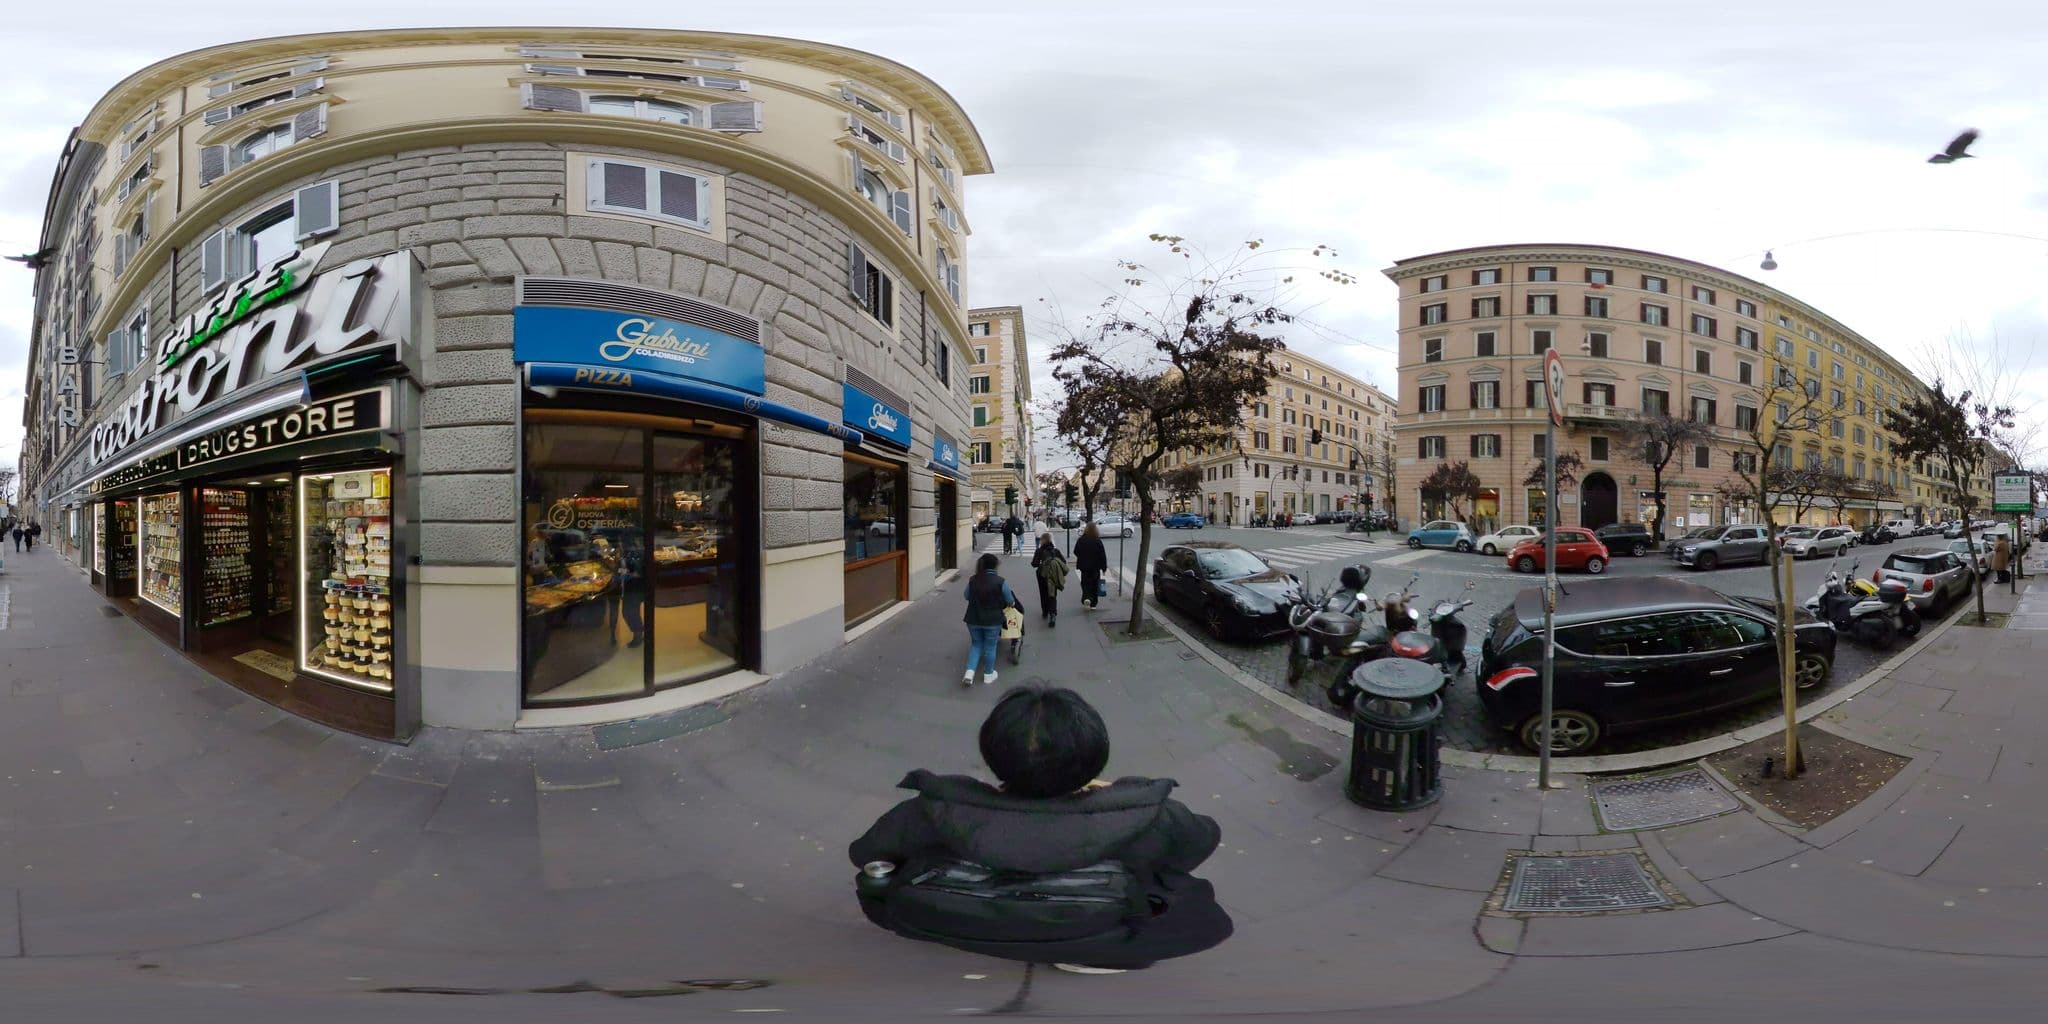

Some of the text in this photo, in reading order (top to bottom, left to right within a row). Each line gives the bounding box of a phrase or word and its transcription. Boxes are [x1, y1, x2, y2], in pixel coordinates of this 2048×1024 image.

[600, 318, 710, 361] Gabrini
[58, 346, 80, 428] BAR
[574, 367, 633, 388] PIZZA
[186, 400, 355, 463] DRUGSTORE
[577, 519, 625, 529] OSTERIA
